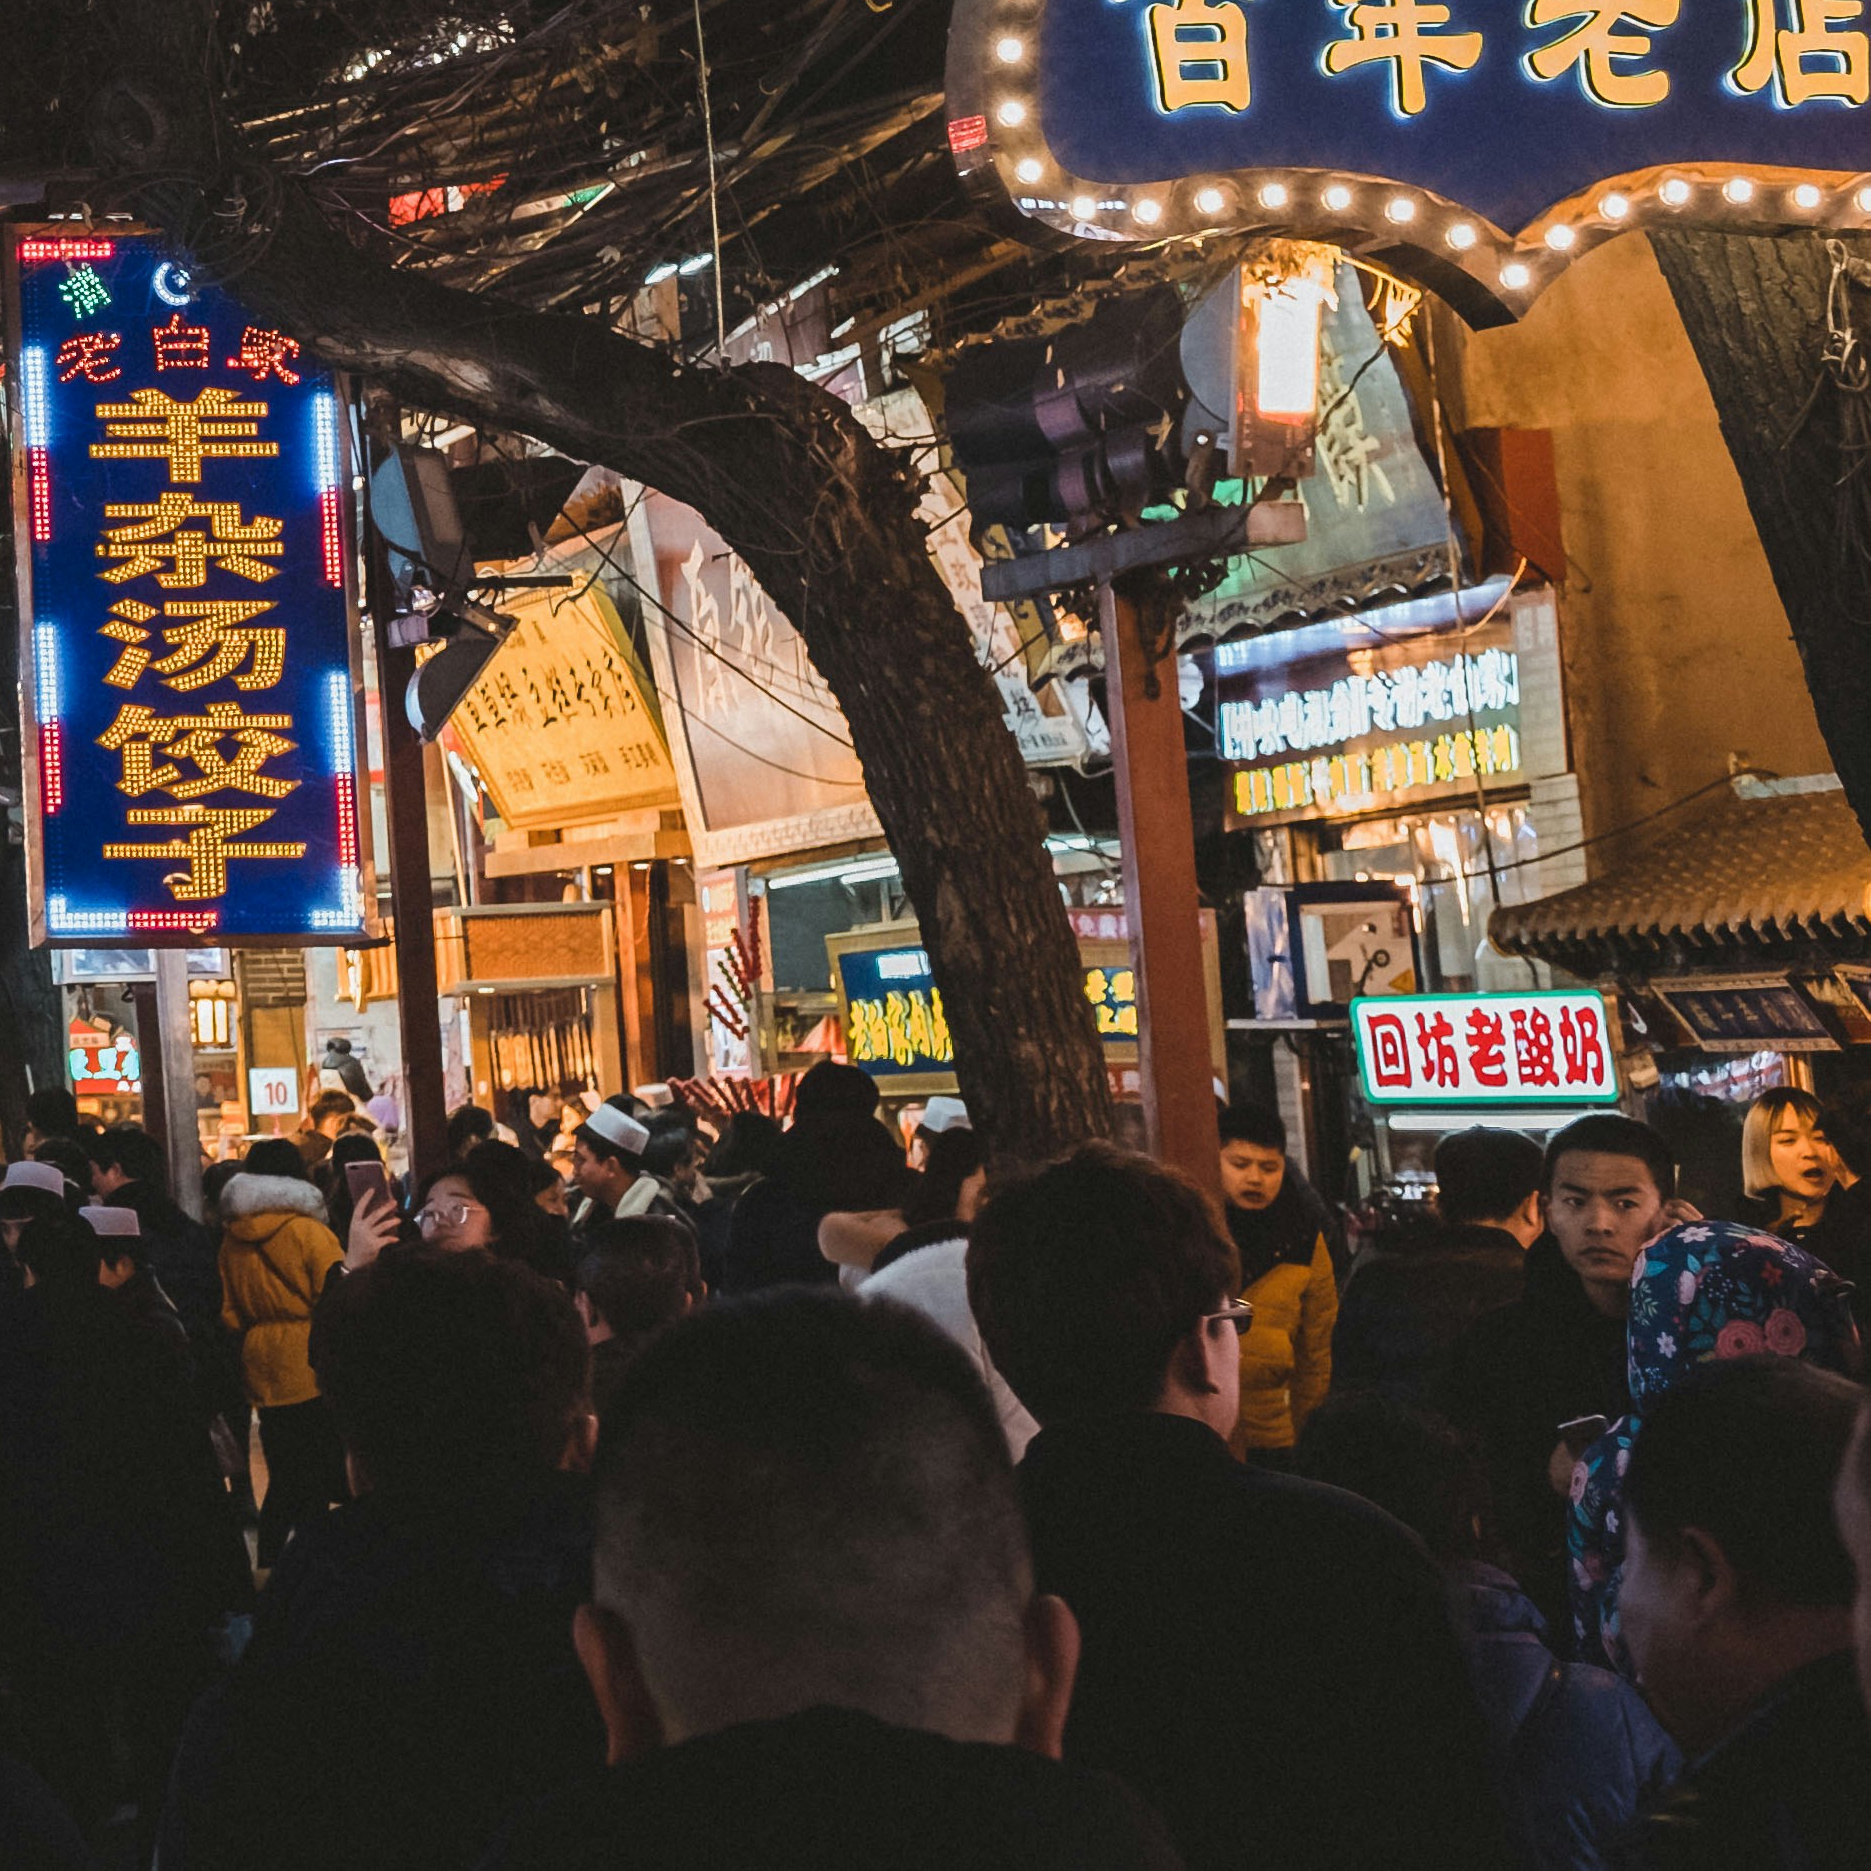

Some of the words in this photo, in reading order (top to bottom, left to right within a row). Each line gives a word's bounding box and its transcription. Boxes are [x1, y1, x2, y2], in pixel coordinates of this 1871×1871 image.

[88, 385, 308, 902] 羊杂汤饺子
[1366, 1005, 1605, 1090] 回坊老酸奶
[264, 1080, 289, 1107] 10
